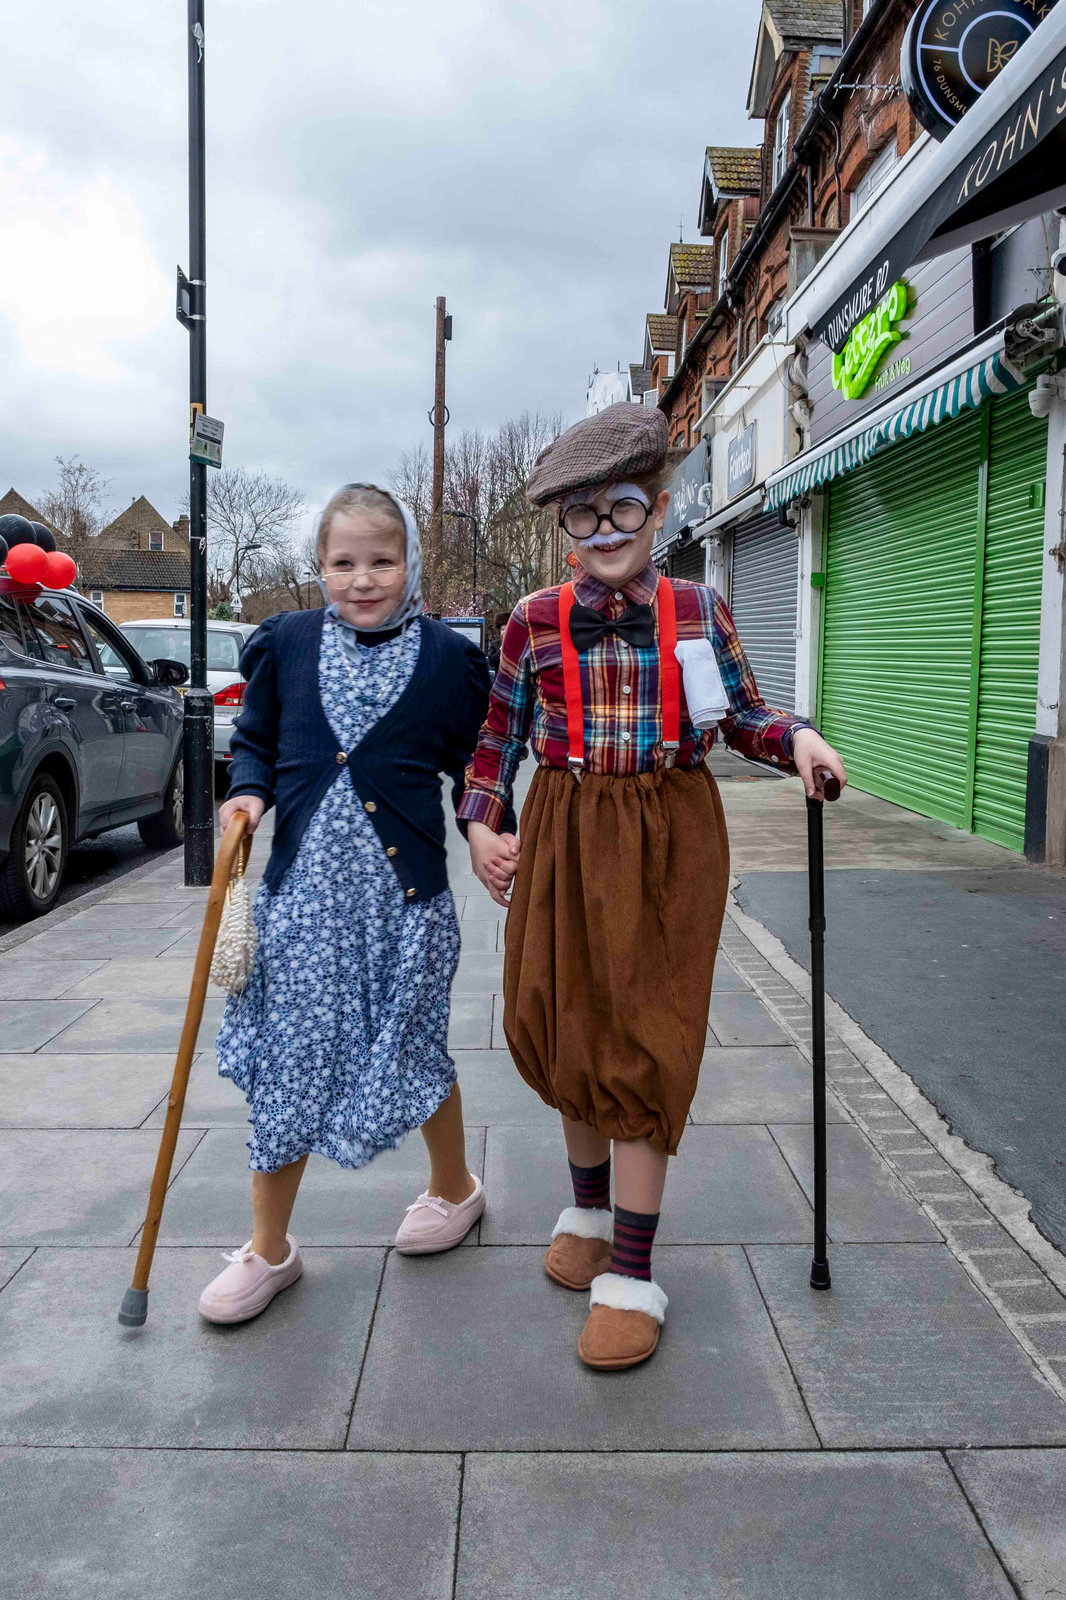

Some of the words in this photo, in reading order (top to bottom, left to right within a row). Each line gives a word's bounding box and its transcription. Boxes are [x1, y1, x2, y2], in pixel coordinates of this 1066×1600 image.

[933, 0, 983, 41] KOH
[933, 58, 942, 72] 76
[828, 276, 873, 350] DUNSMURE
[875, 260, 889, 299] RD
